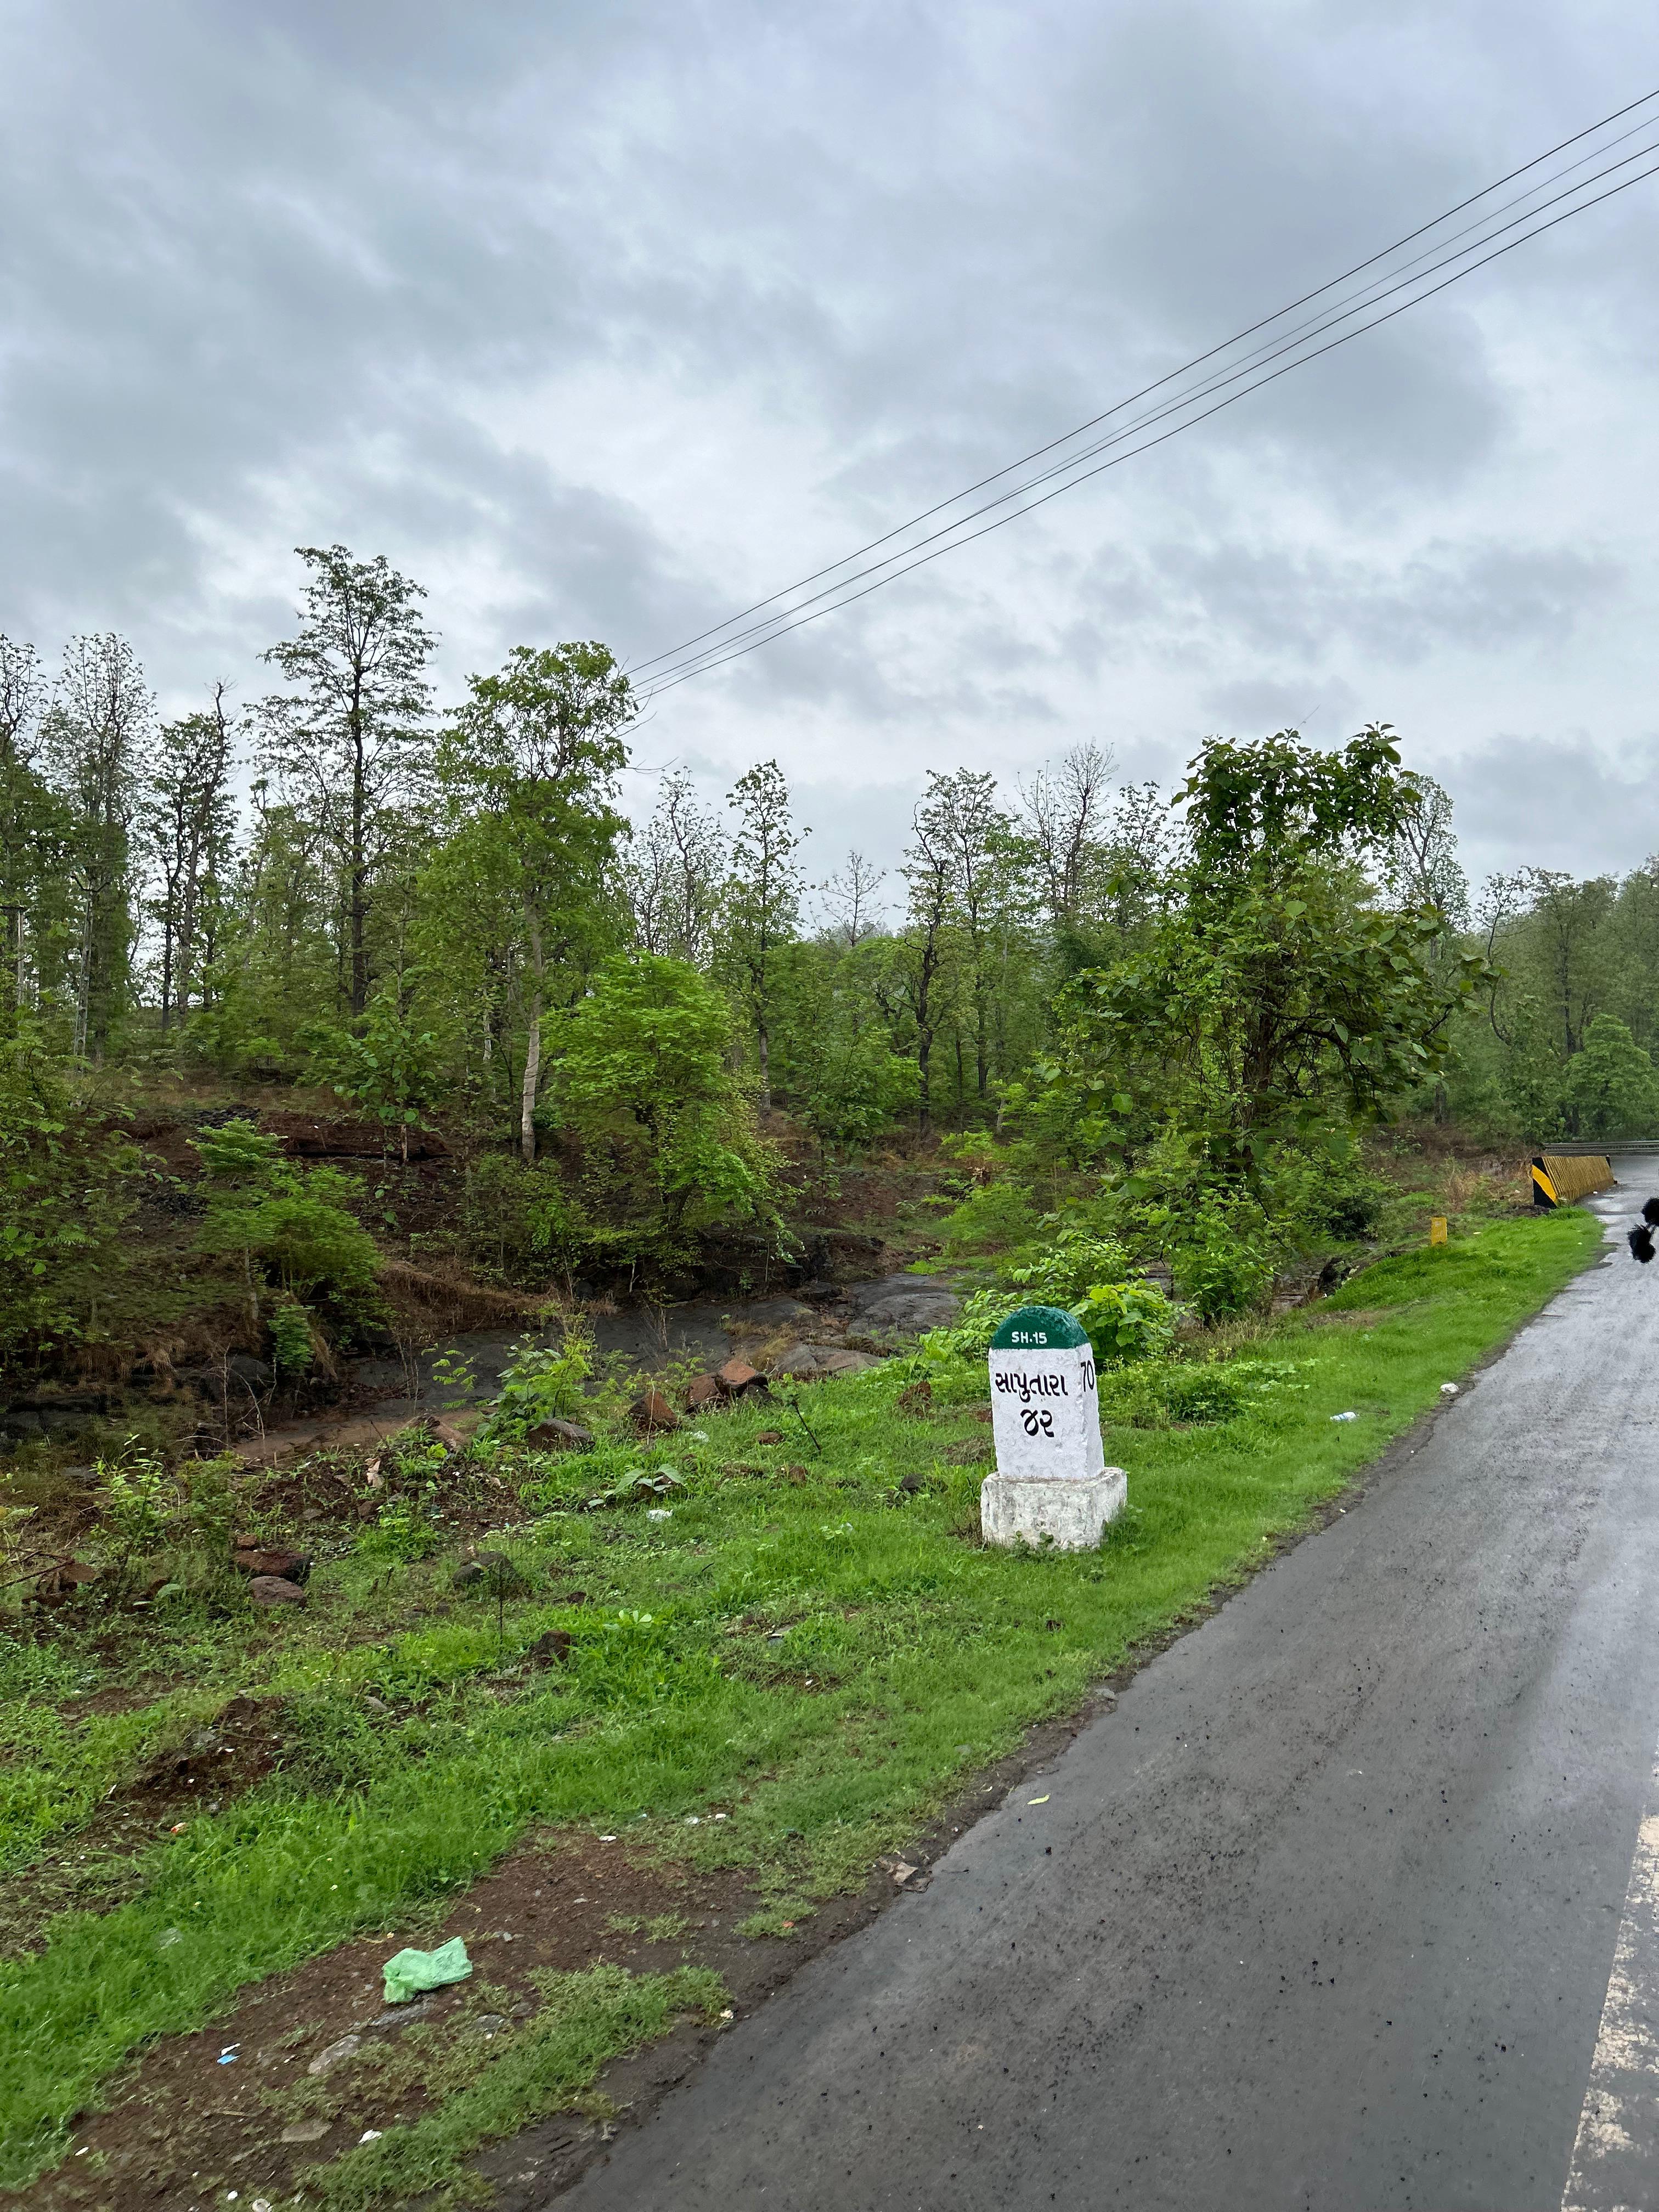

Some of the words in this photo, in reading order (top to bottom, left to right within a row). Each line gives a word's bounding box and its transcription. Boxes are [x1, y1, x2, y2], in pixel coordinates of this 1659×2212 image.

[995, 1372, 1069, 1403] સાપુતારા
[1080, 1360, 1094, 1392] 70
[1020, 1409, 1054, 1437] ૪૨
